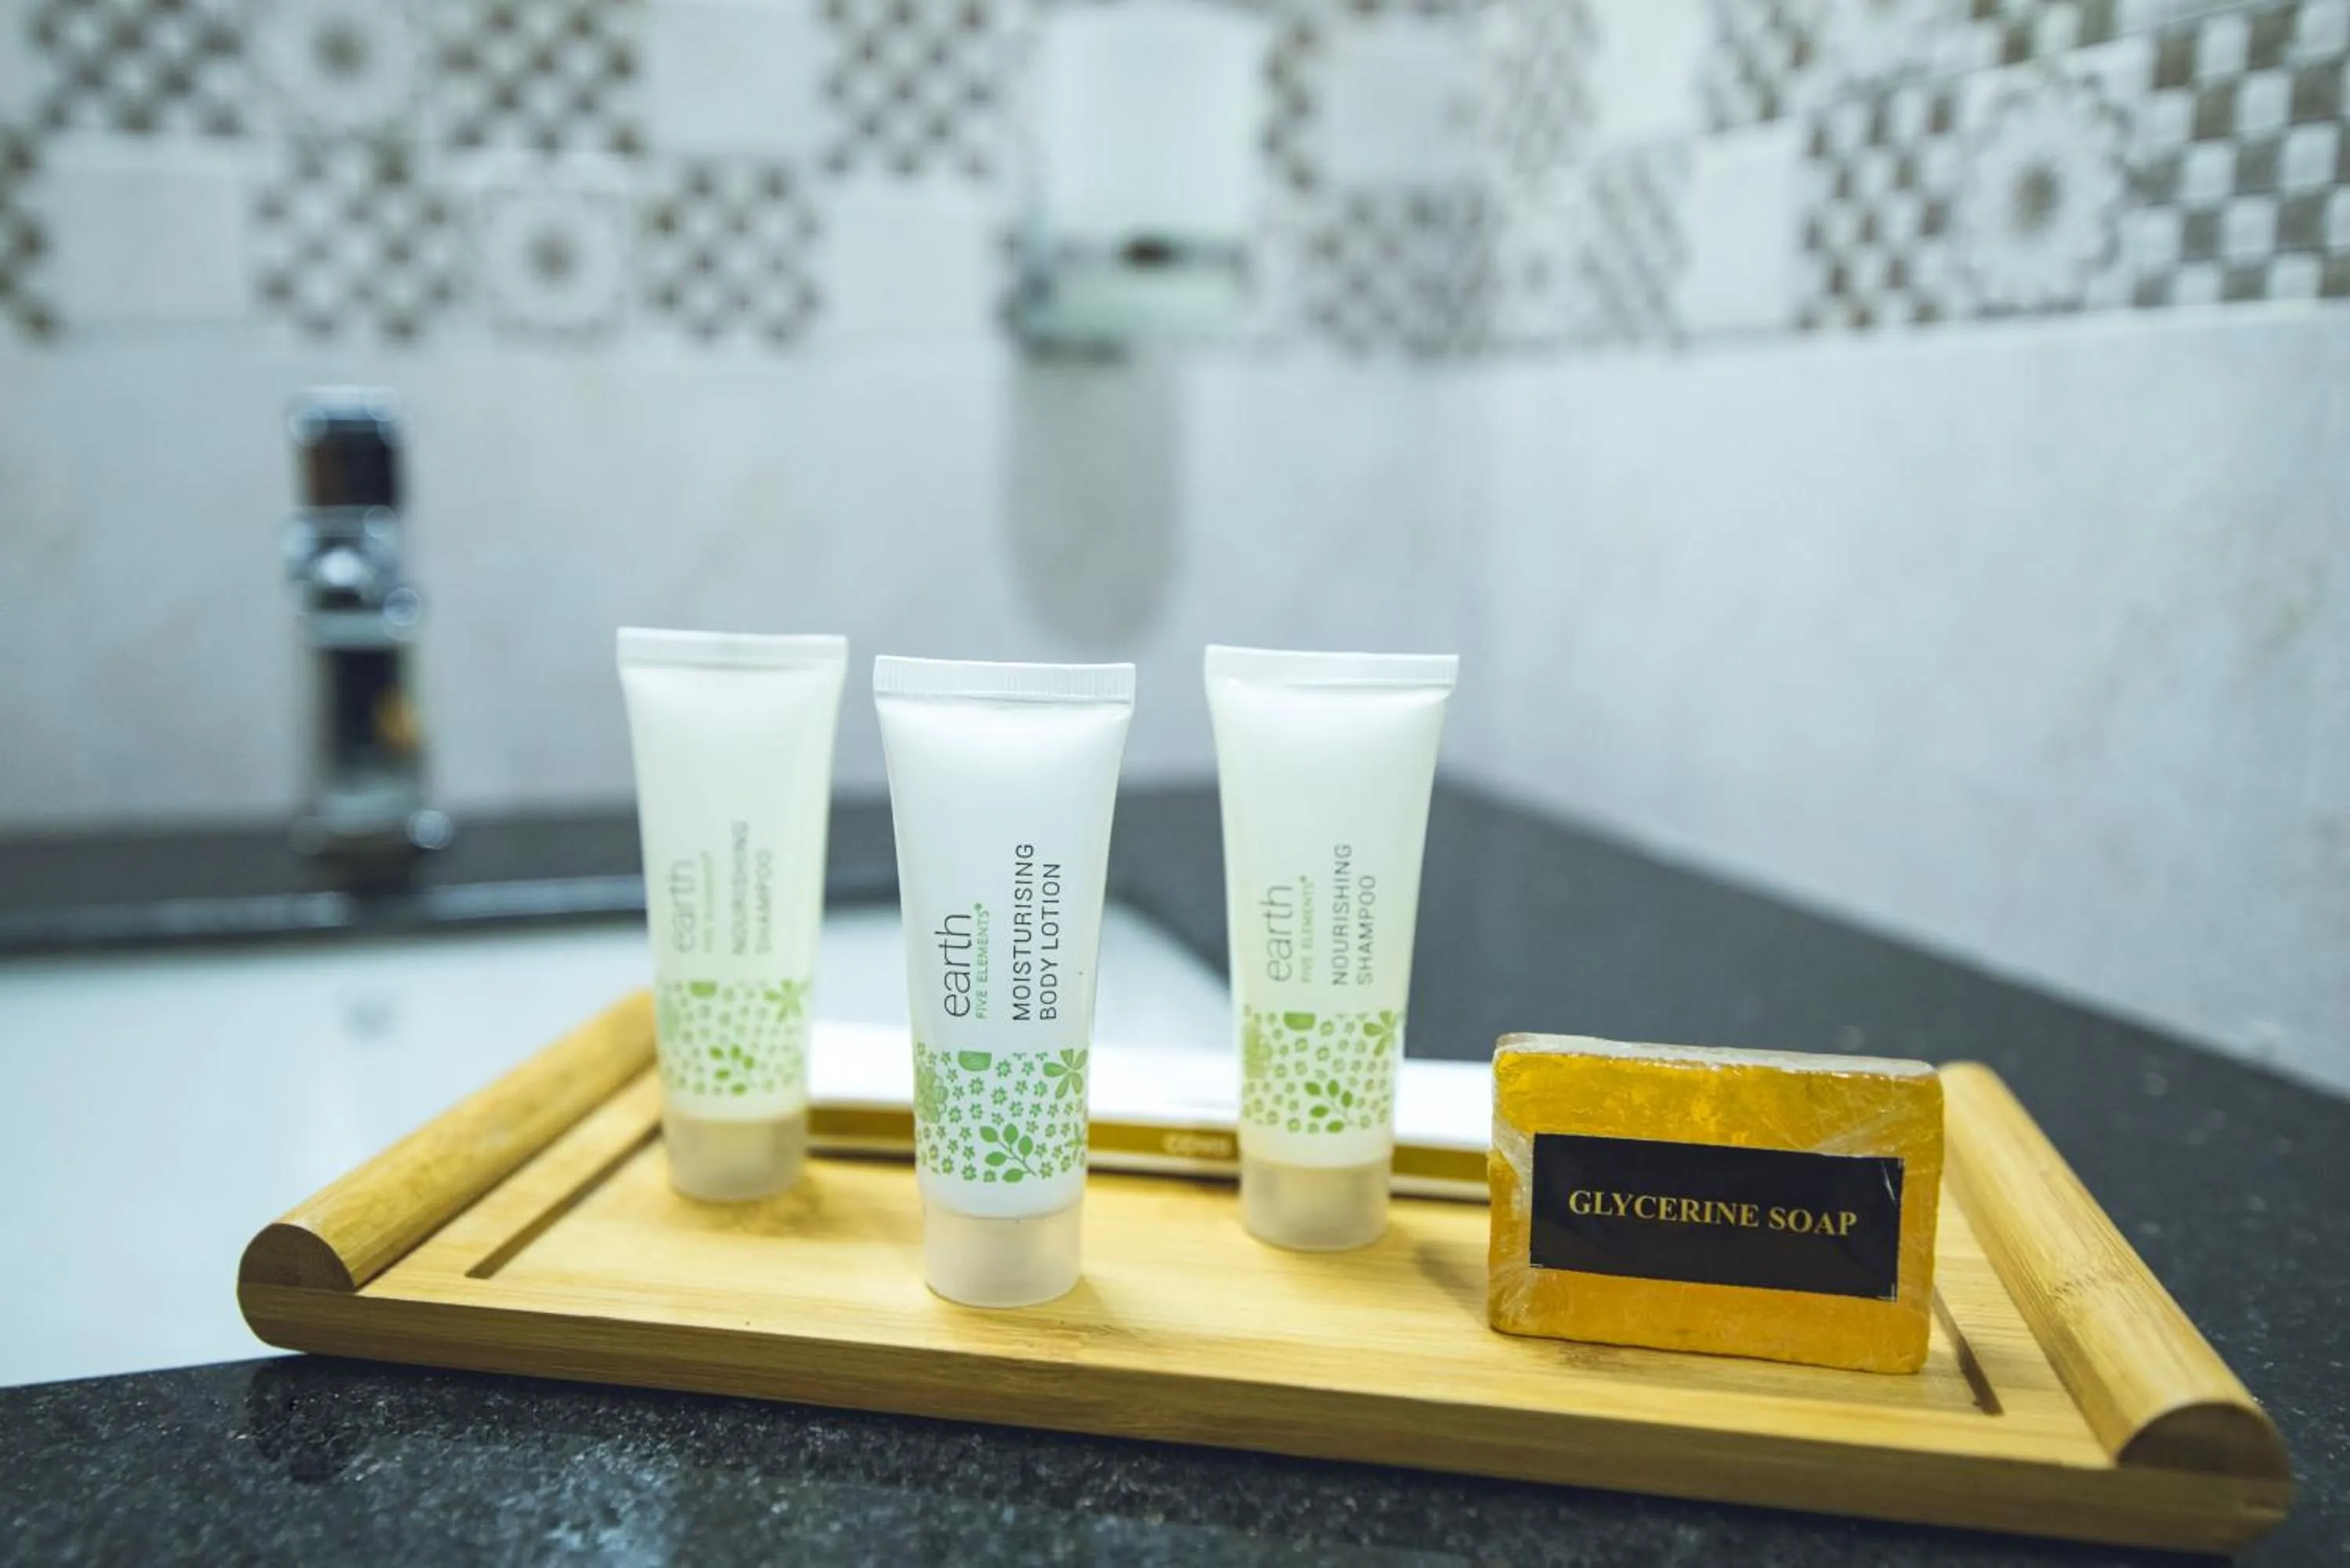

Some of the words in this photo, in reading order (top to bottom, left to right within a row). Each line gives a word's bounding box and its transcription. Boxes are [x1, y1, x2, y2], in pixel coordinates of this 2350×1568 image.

[666, 860, 696, 955] earth
[1012, 844, 1034, 1021] MOISTURISING
[1040, 863, 1061, 951] LOTION
[1258, 886, 1293, 982] earth
[1332, 844, 1352, 986] NOURISHING
[1356, 875, 1376, 986] SHAMPOO
[934, 914, 972, 1017] earth
[975, 990, 988, 1020] FIVE
[1039, 958, 1059, 1021] BODY
[1568, 1190, 1759, 1228] GLYCERINE
[1768, 1206, 1858, 1237] SOAP
